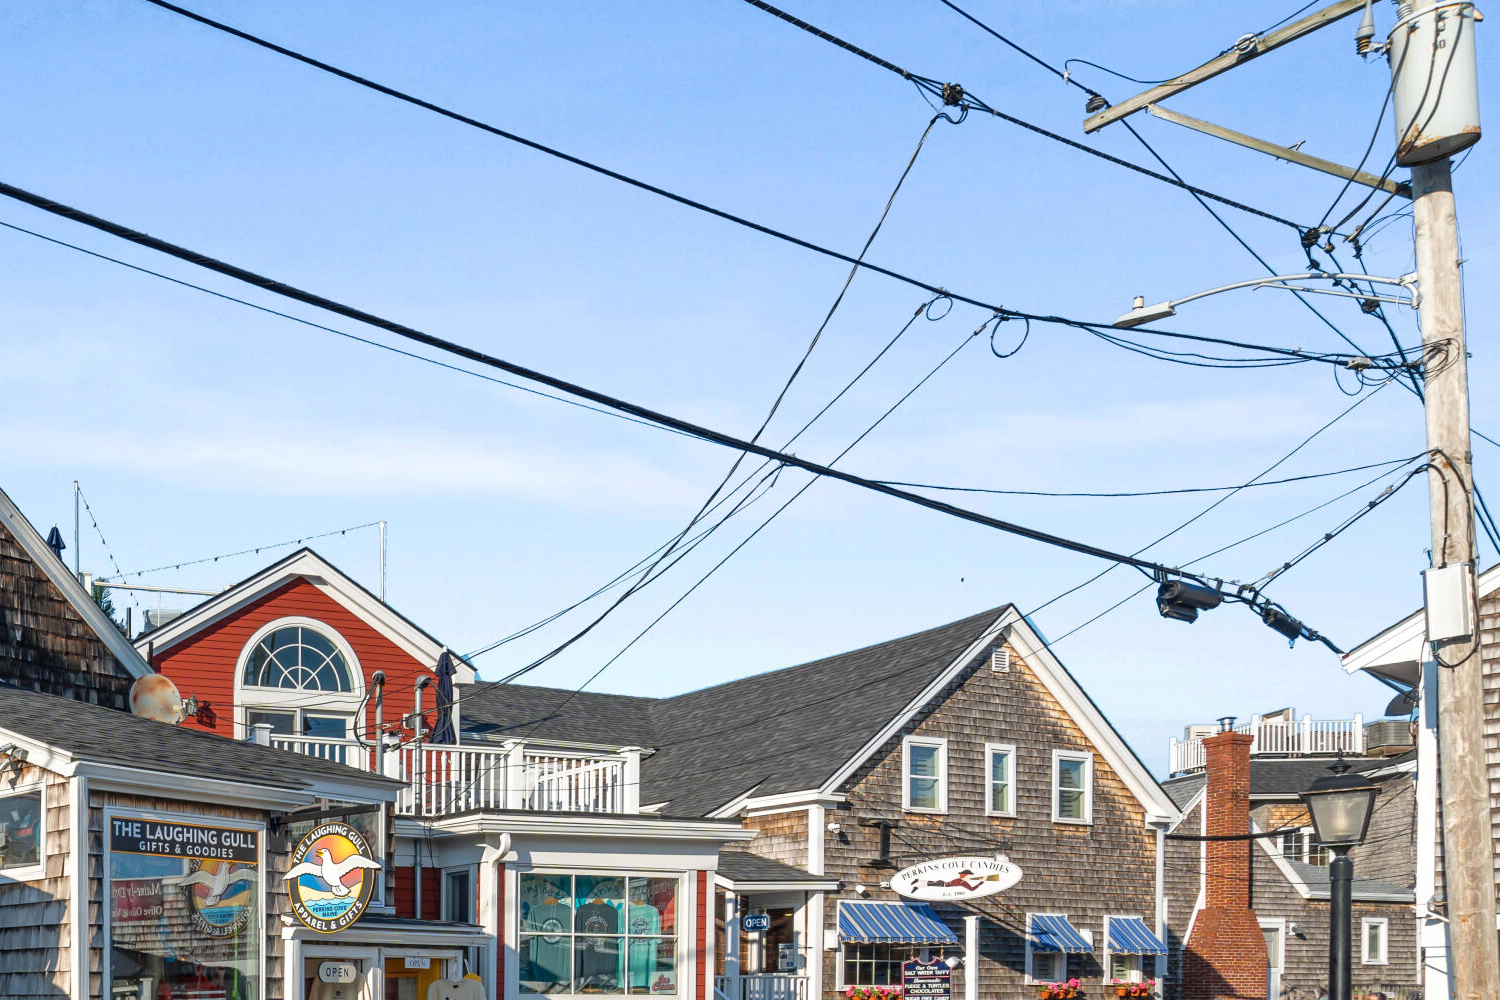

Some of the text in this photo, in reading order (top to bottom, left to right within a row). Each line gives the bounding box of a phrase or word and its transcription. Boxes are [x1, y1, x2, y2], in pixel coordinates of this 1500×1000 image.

[112, 820, 255, 849] THE LAUGHING GULL
[293, 824, 366, 864] THE LAUGHING GULL
[139, 841, 234, 858] GIFTS & GOODIES
[901, 860, 1010, 881] PERKINS COVE CANDIES
[294, 900, 363, 930] APPAREL & GIFTS
[745, 918, 767, 928] OPEN
[325, 967, 349, 977] OPEN
[409, 958, 425, 967] OPEN
